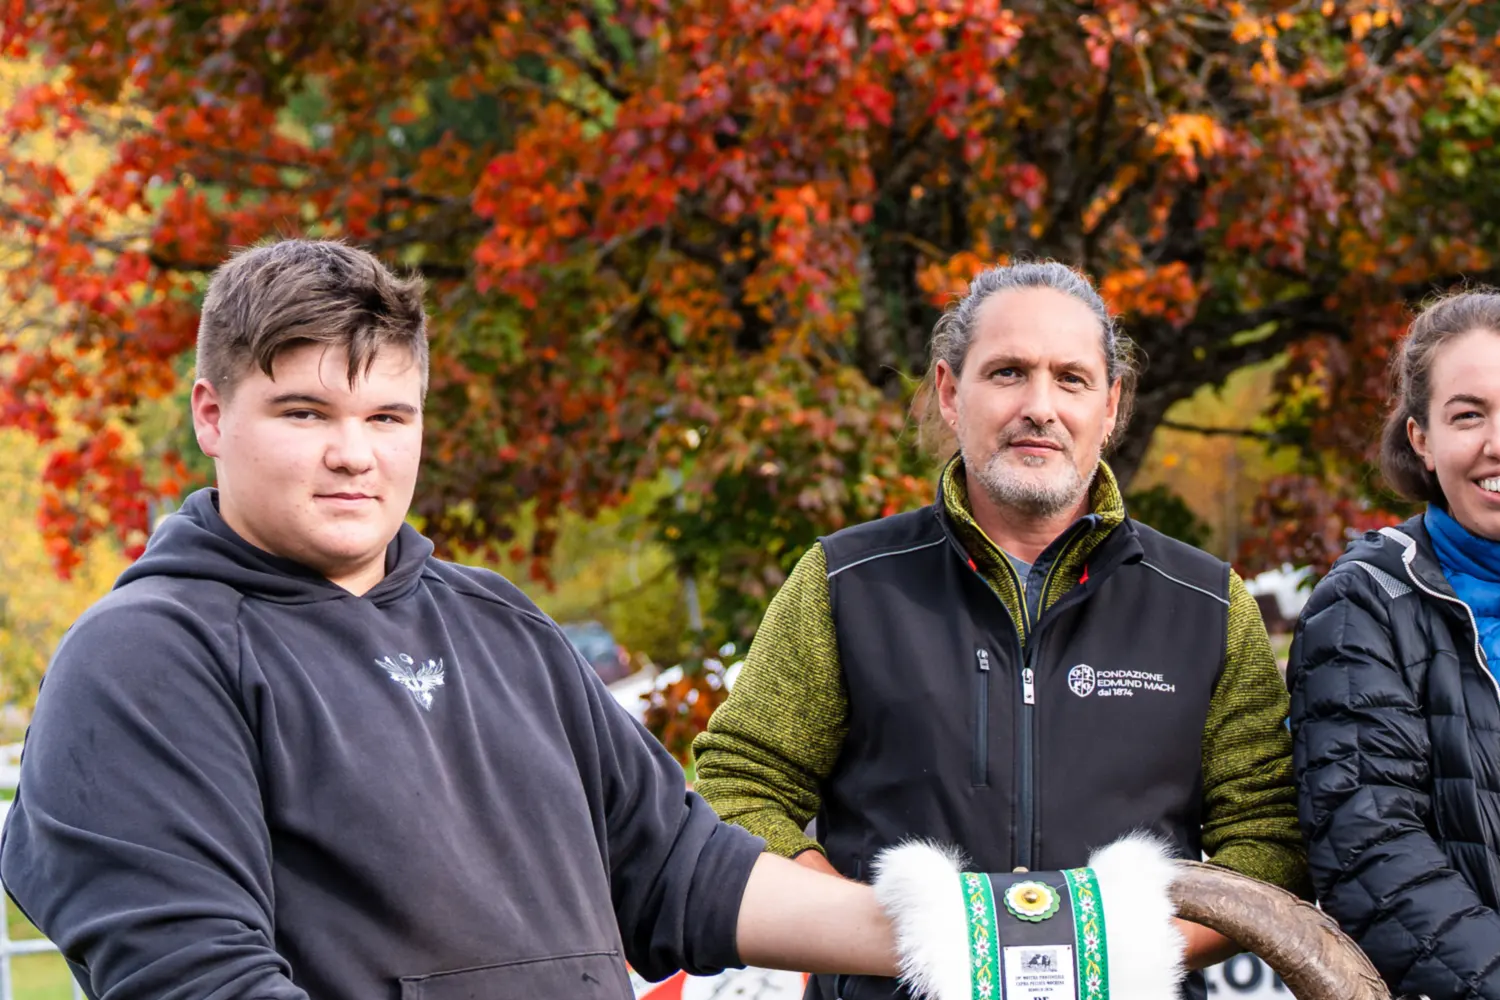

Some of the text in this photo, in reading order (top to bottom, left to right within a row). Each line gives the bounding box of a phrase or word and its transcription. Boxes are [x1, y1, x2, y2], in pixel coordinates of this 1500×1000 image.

[1096, 669, 1164, 683] FONDAZIONE
[1096, 679, 1176, 693] EDMUND MACH
[1097, 688, 1134, 697] dal 1874
